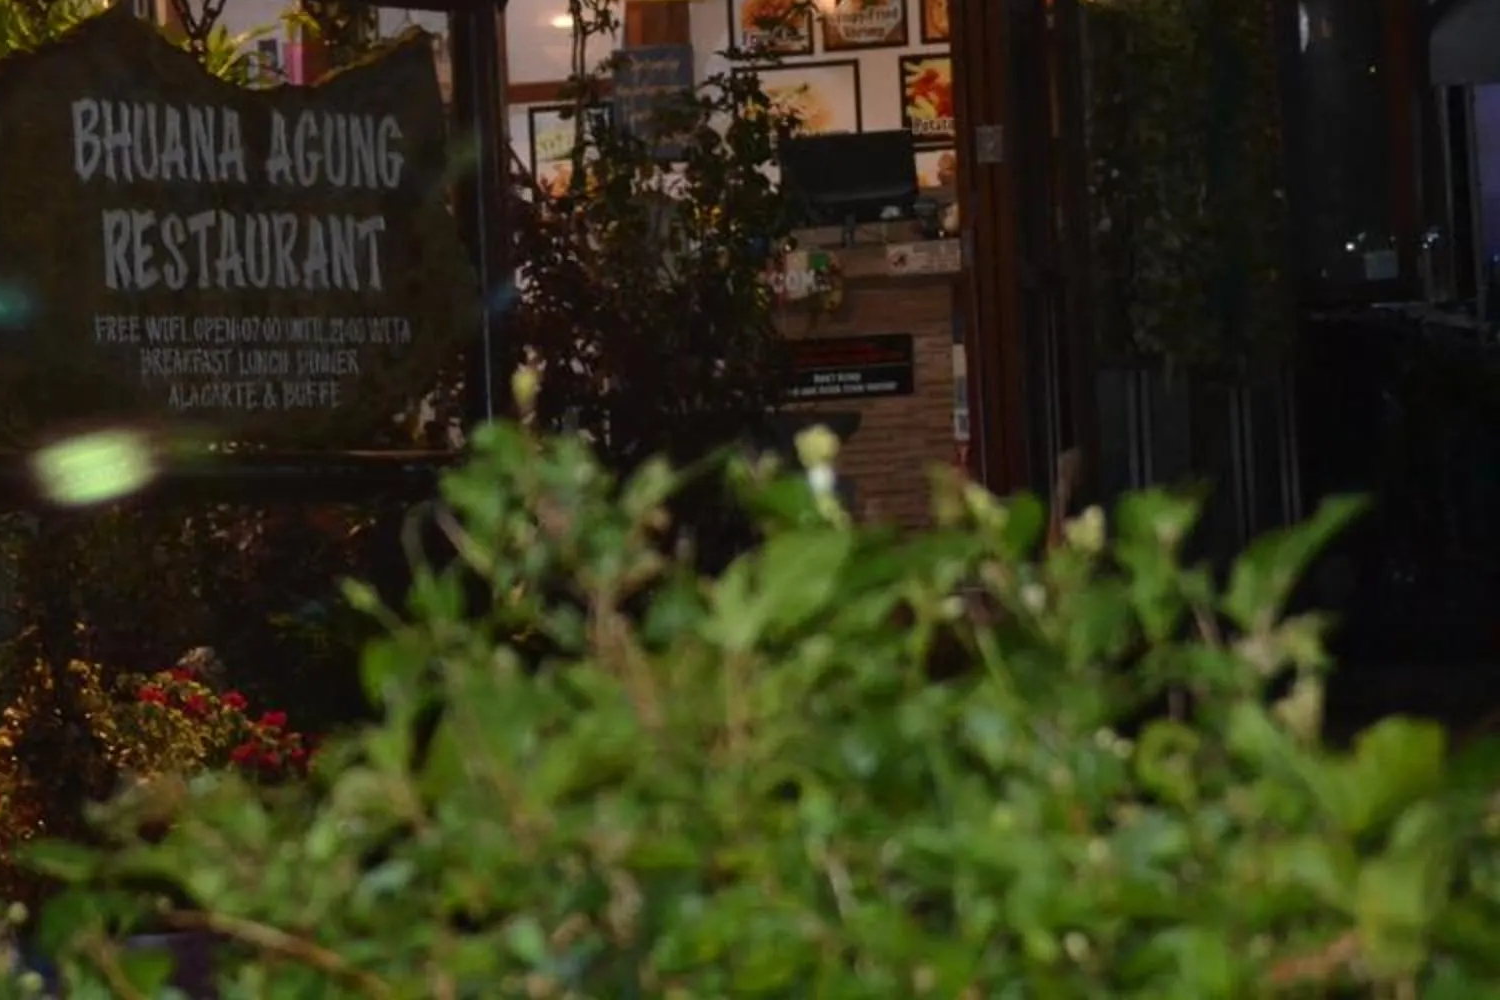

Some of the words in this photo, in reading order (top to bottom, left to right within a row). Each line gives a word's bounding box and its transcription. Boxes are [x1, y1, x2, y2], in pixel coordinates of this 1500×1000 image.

[71, 98, 247, 185] BHUANA
[265, 107, 405, 189] AGUNG
[102, 208, 386, 292] RESTAURANT
[94, 313, 141, 343] FREE
[139, 347, 233, 379] BREAKFAST
[238, 348, 289, 376] LUNCH
[296, 348, 360, 378] DINNER
[263, 381, 277, 410] &
